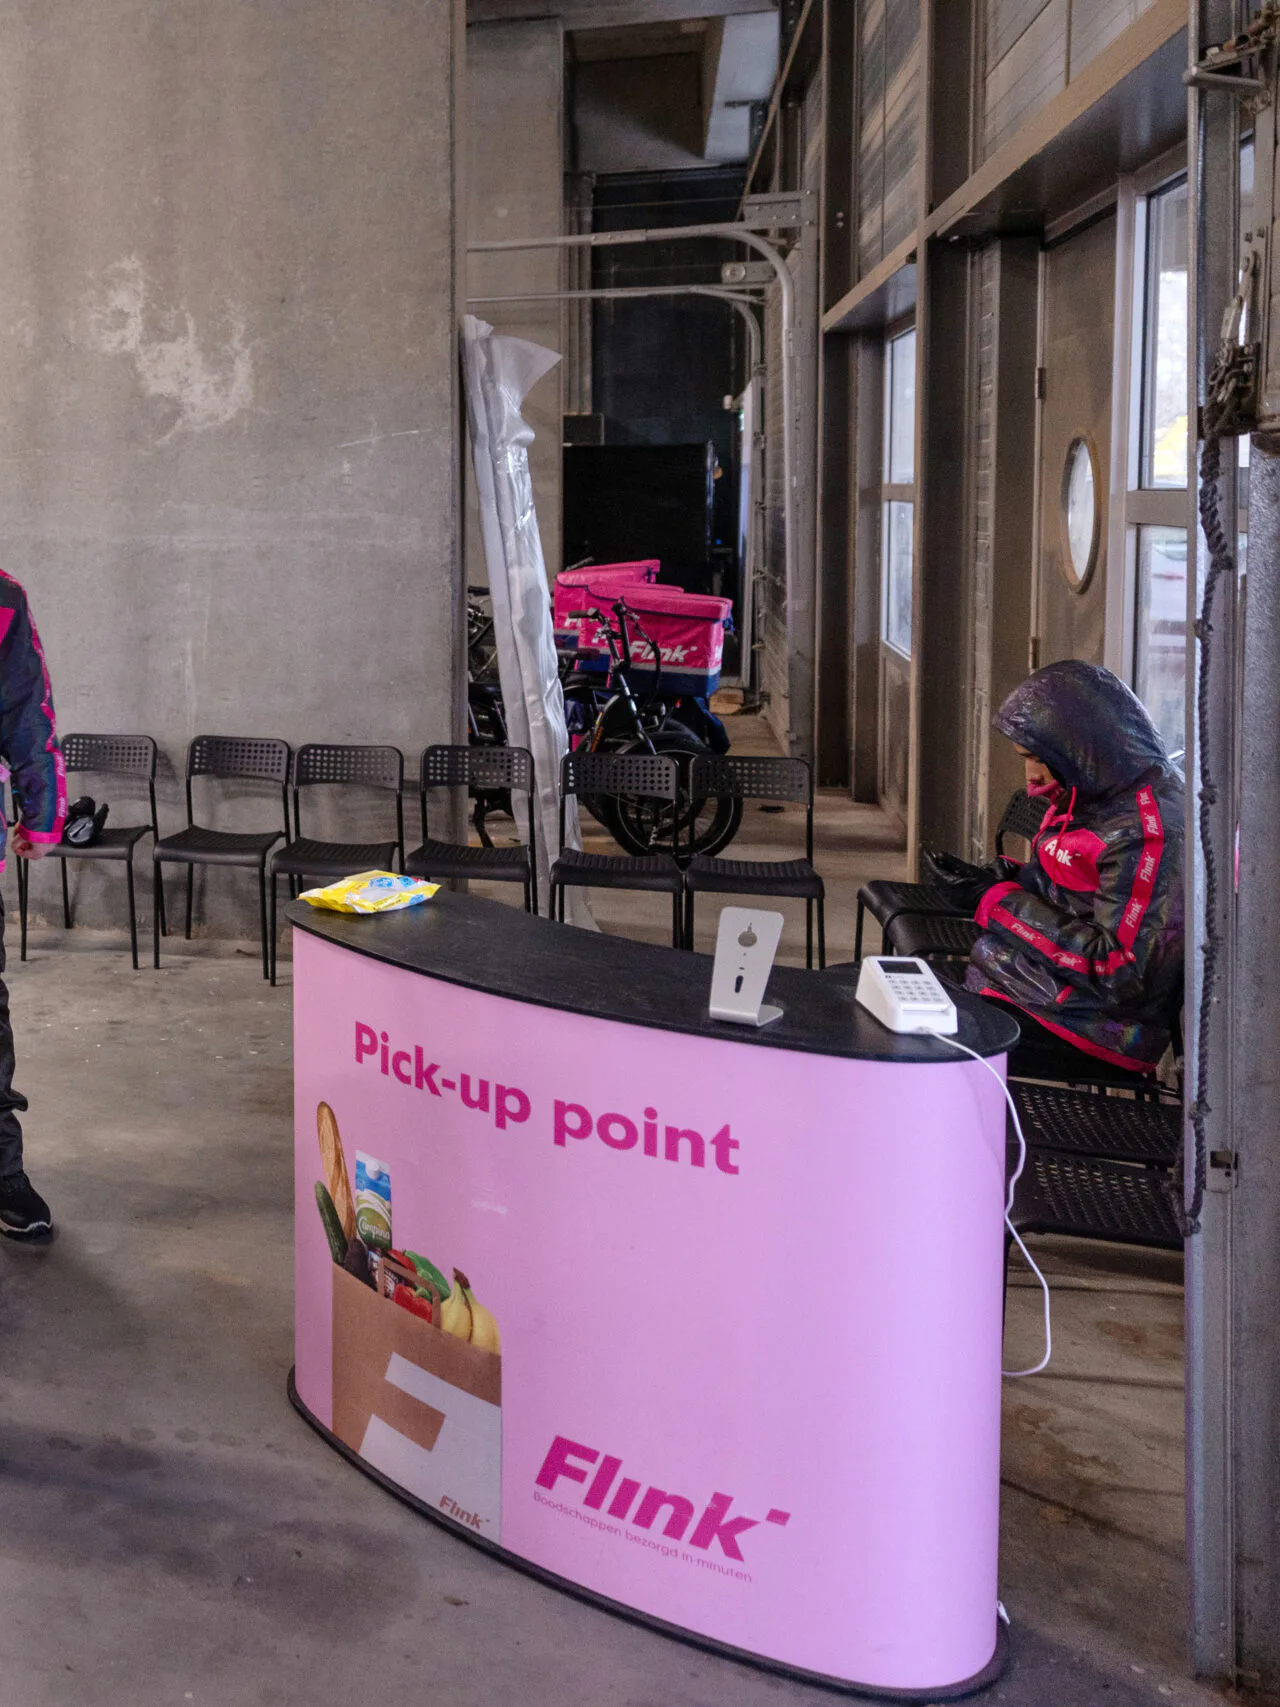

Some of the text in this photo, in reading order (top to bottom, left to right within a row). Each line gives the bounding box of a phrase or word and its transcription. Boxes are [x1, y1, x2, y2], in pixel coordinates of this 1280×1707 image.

[1143, 812, 1159, 836] Flink
[1140, 852, 1156, 883] Flink
[1125, 897, 1143, 928] Flink
[1011, 922, 1041, 941] Flink
[355, 1021, 740, 1175] Pick-up point
[439, 1494, 490, 1530] Flink
[535, 1435, 791, 1562] Flink
[533, 1491, 753, 1584] Boodschappen bezorgd in minuten
